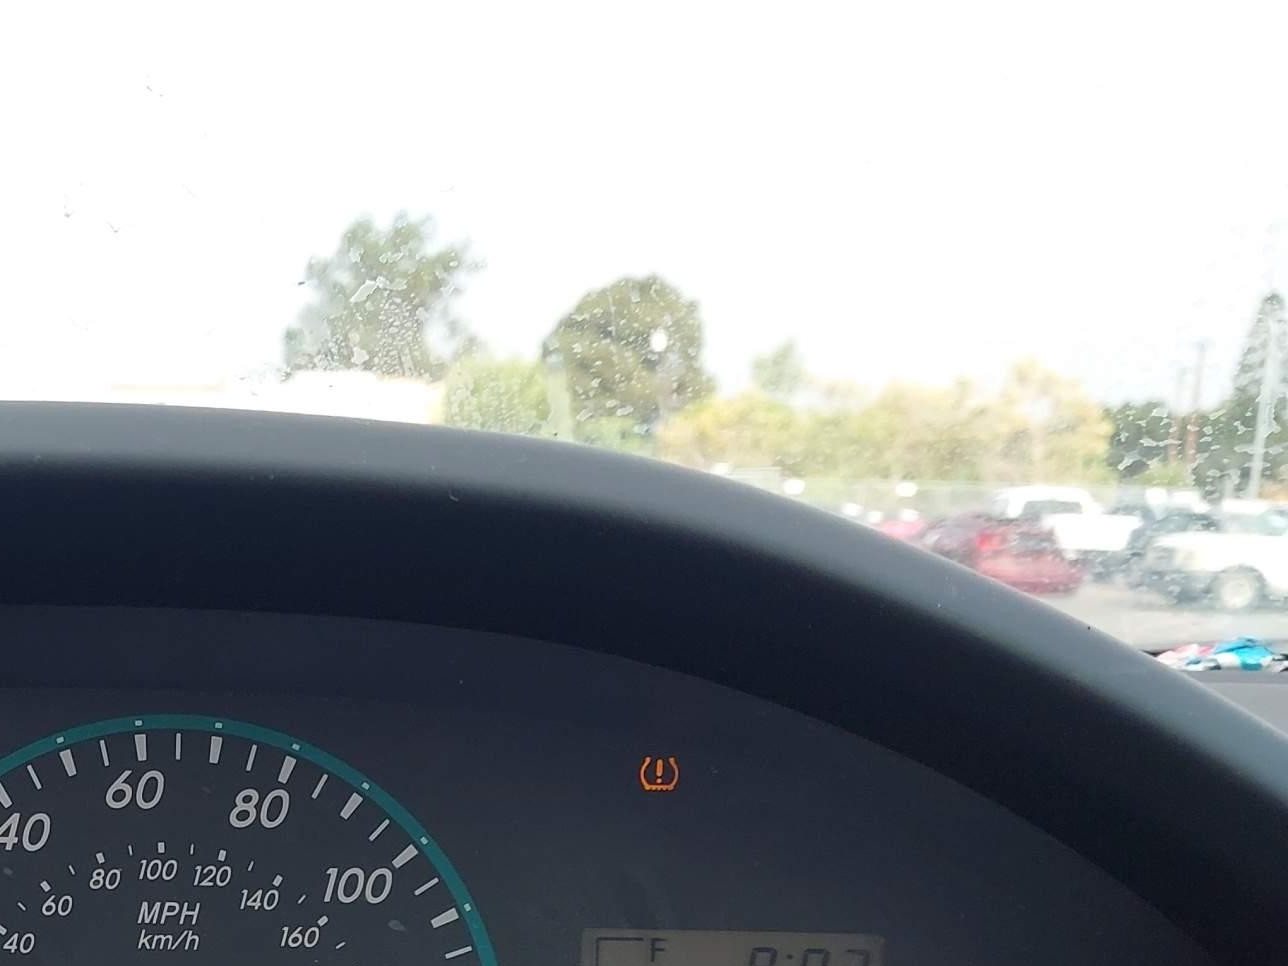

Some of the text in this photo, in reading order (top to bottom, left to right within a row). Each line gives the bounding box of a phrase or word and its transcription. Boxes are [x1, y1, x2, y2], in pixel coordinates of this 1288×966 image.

[106, 770, 165, 810] 60
[229, 788, 290, 829] 80
[89, 869, 121, 889] 80
[138, 859, 178, 881] 100
[193, 865, 232, 887] 120
[324, 866, 392, 903] 100
[41, 895, 73, 916] 60
[239, 890, 279, 911] 140
[137, 902, 200, 924] MPH
[3, 932, 35, 954] 40
[137, 929, 200, 951] km/h
[280, 927, 320, 948] 160
[649, 939, 667, 963] F
